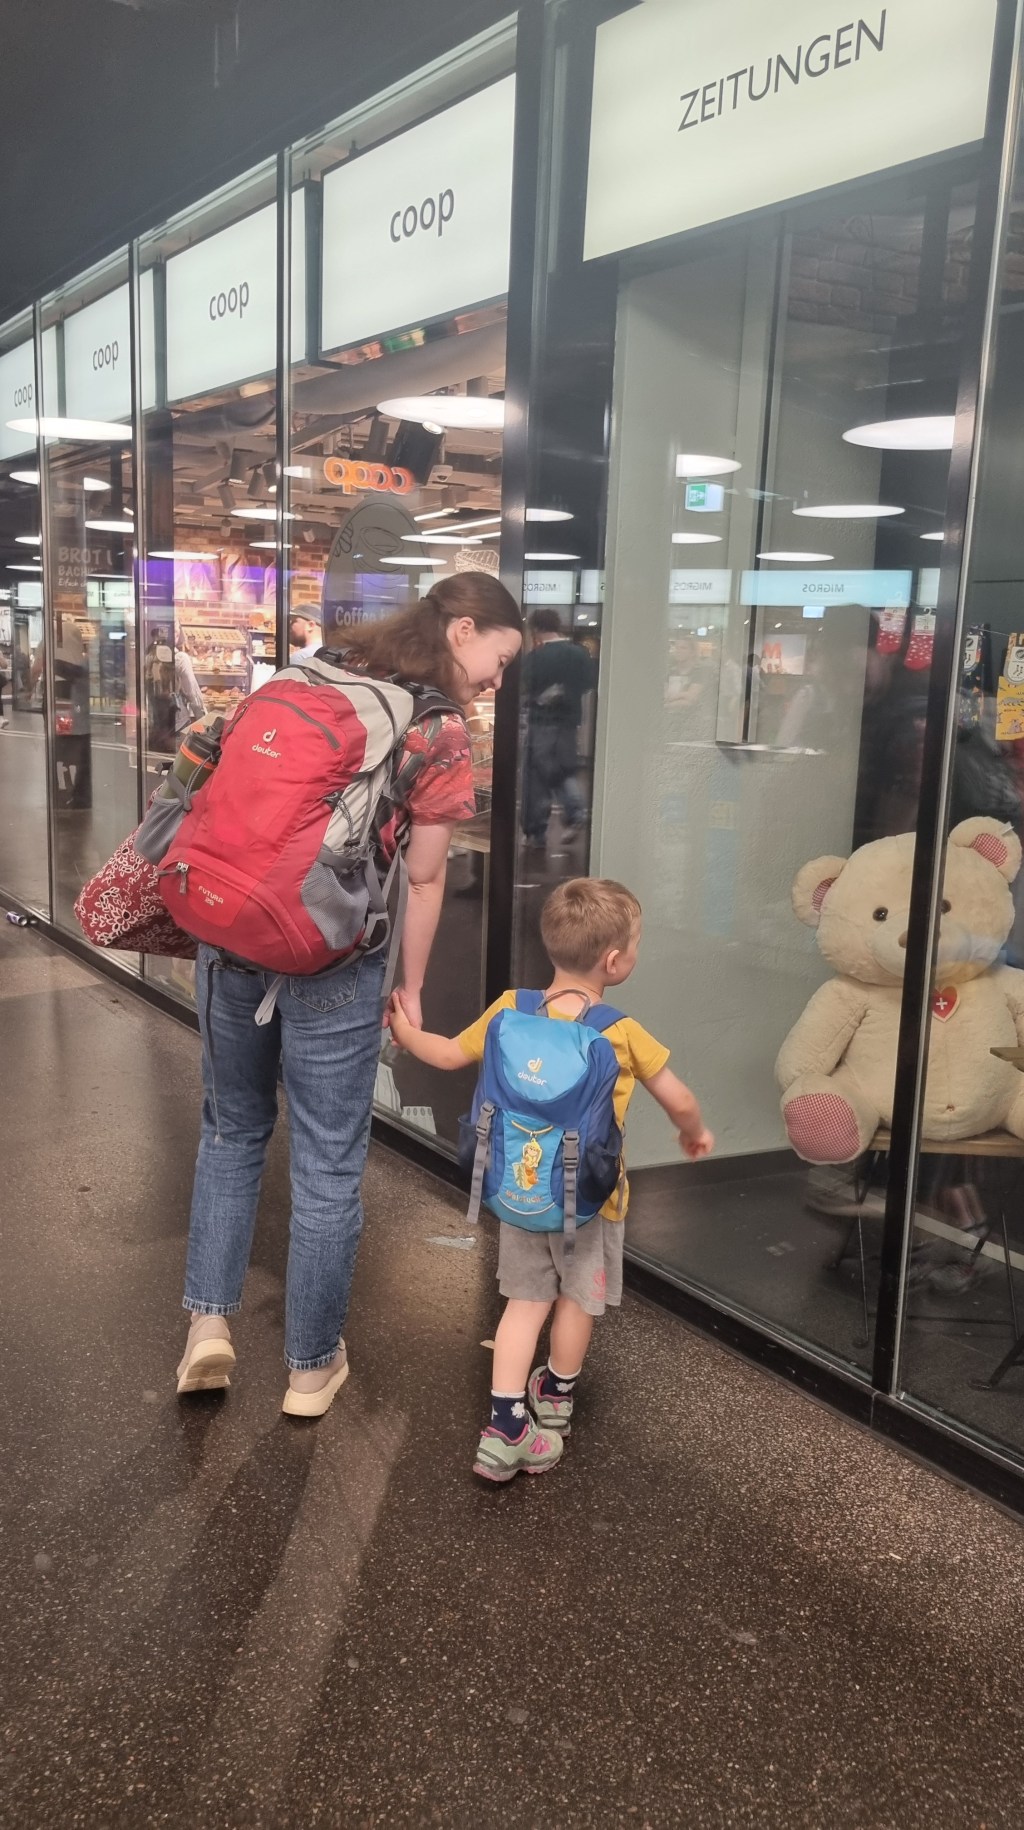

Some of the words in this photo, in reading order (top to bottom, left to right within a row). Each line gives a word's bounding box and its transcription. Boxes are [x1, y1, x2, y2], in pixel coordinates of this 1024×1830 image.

[678, 9, 887, 131] ZEITUNGEN
[390, 187, 455, 244] coop
[209, 280, 250, 322] coop
[92, 338, 119, 372] coop
[13, 382, 33, 409] coop
[58, 546, 102, 566] BROT
[335, 605, 377, 627] Coffee
[251, 743, 282, 759] deuter
[198, 885, 224, 905] FUTURA
[517, 1070, 547, 1086] deuter
